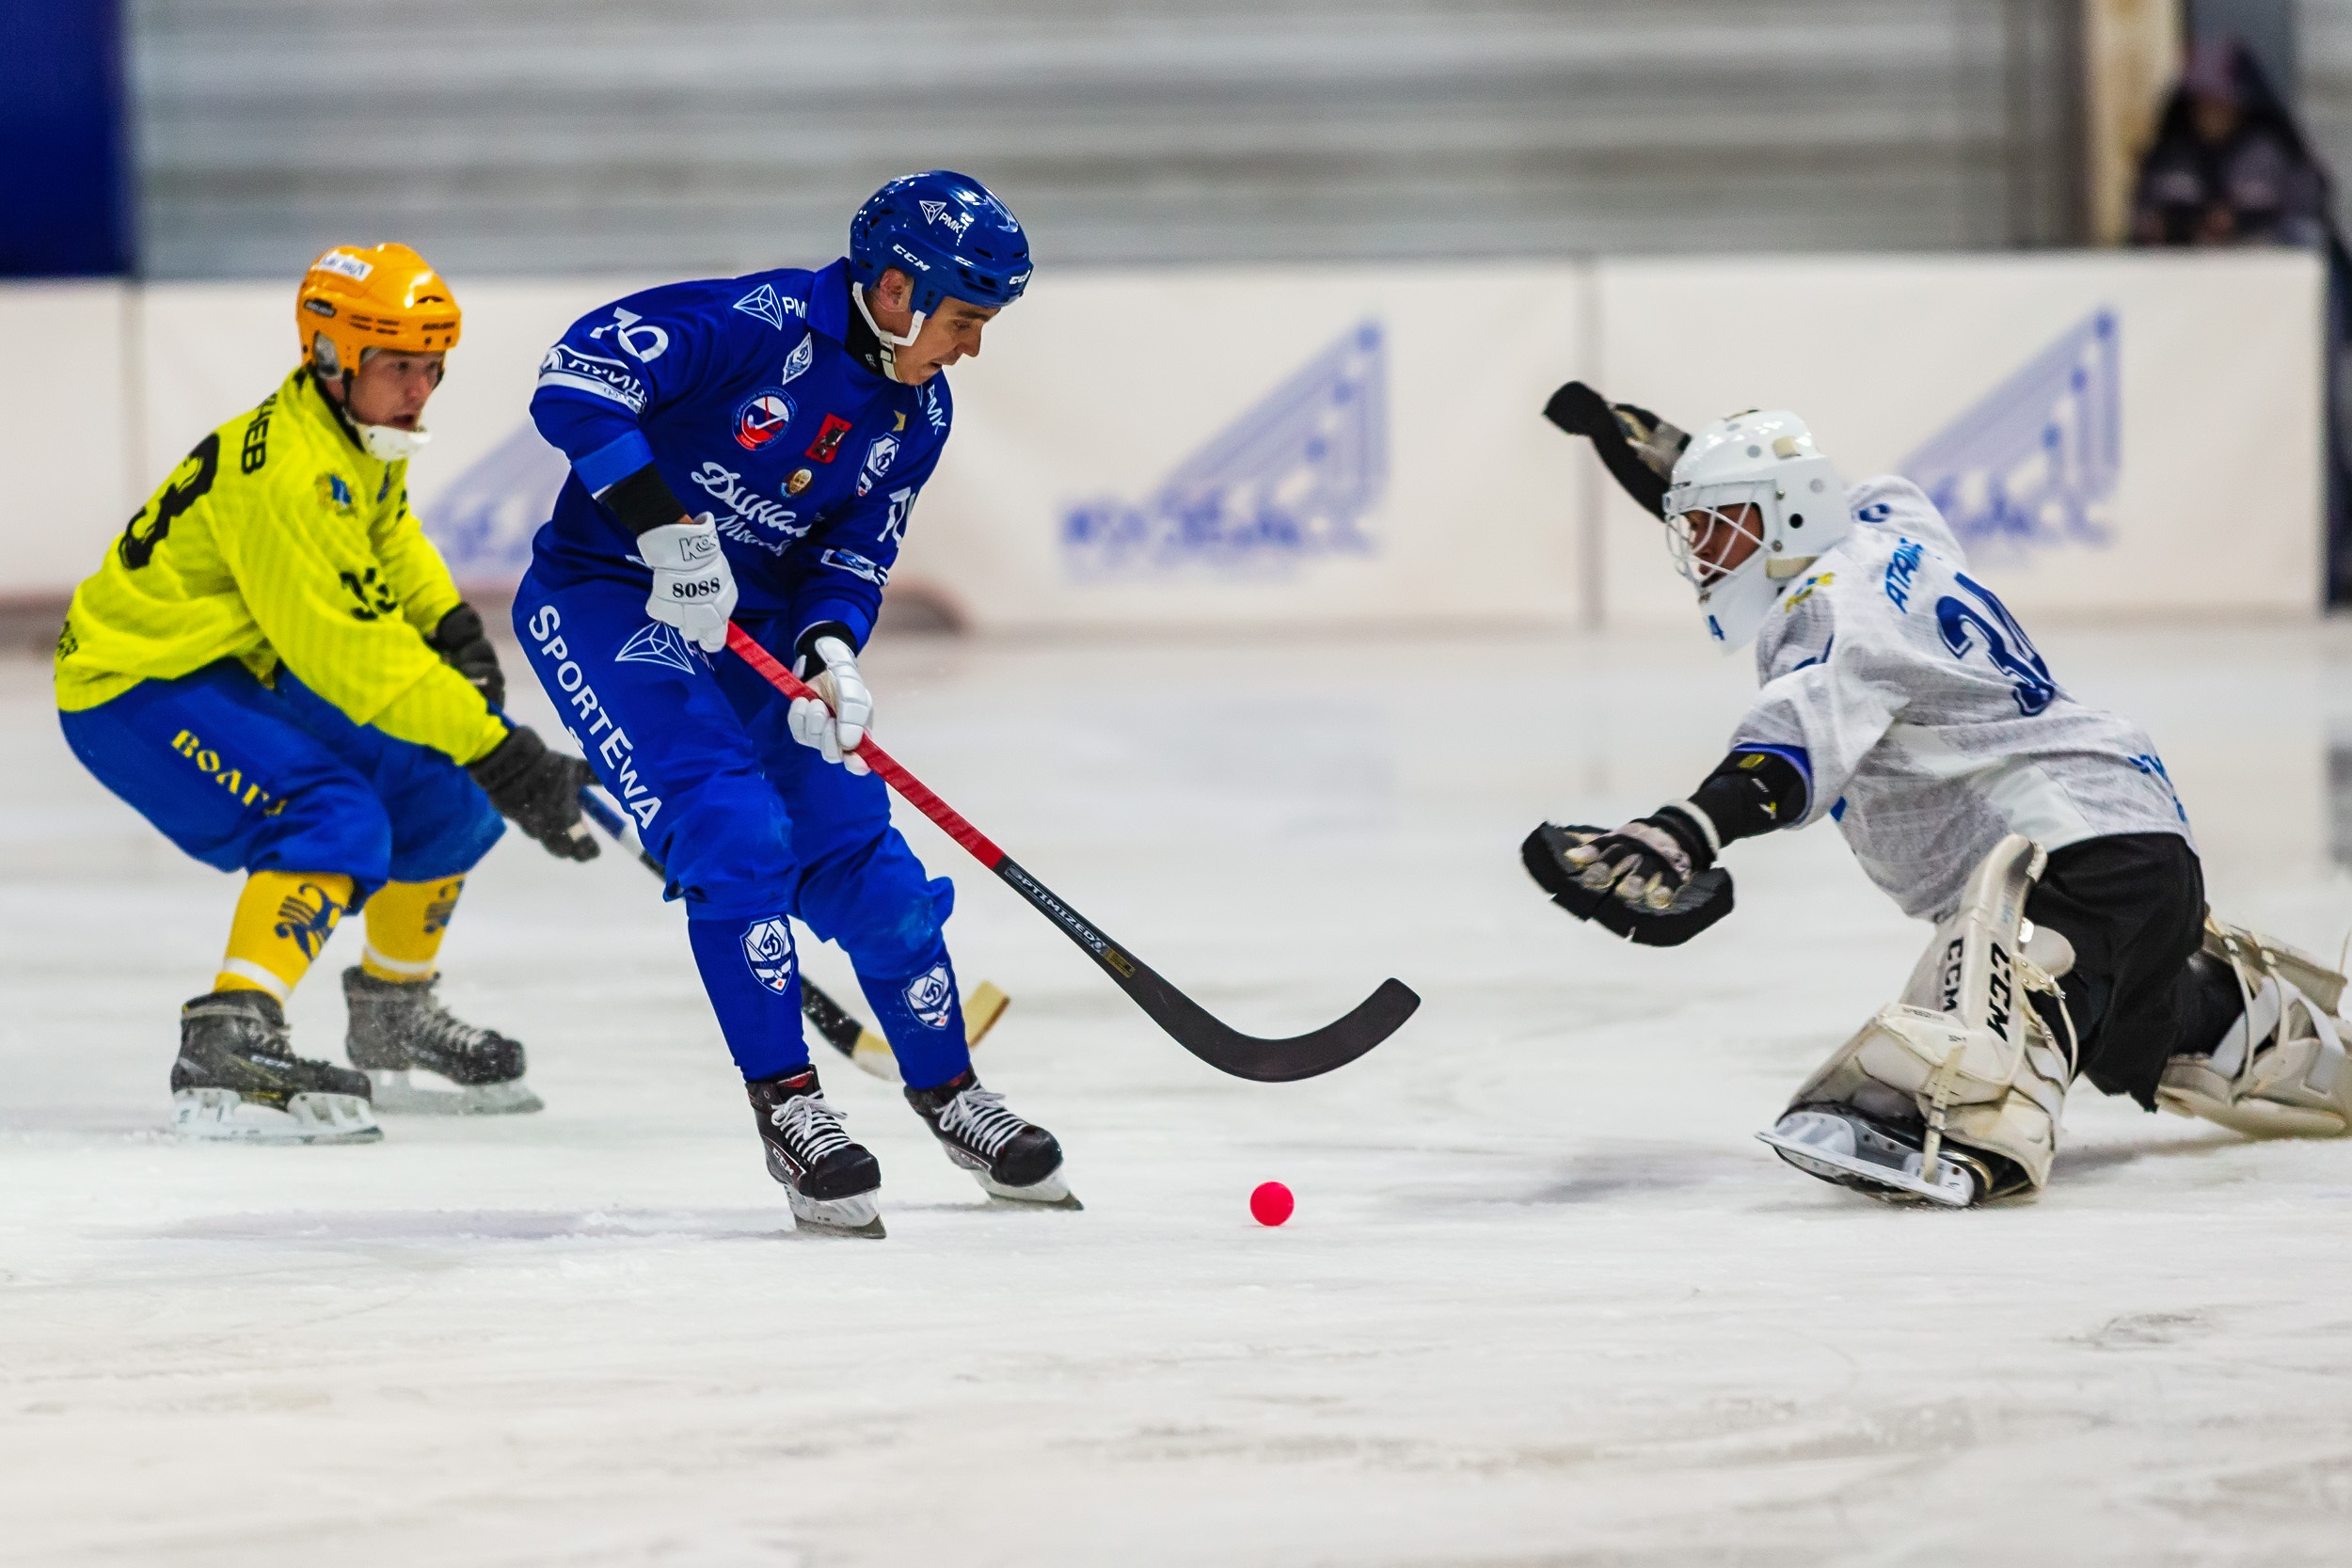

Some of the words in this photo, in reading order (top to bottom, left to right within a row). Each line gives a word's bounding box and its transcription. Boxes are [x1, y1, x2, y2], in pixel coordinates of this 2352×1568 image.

[892, 243, 931, 272] CCM
[672, 577, 721, 598] 8088
[529, 605, 663, 830] SPORTEWA
[1942, 936, 1964, 1013] CCM
[1986, 942, 2011, 1042] CCM
